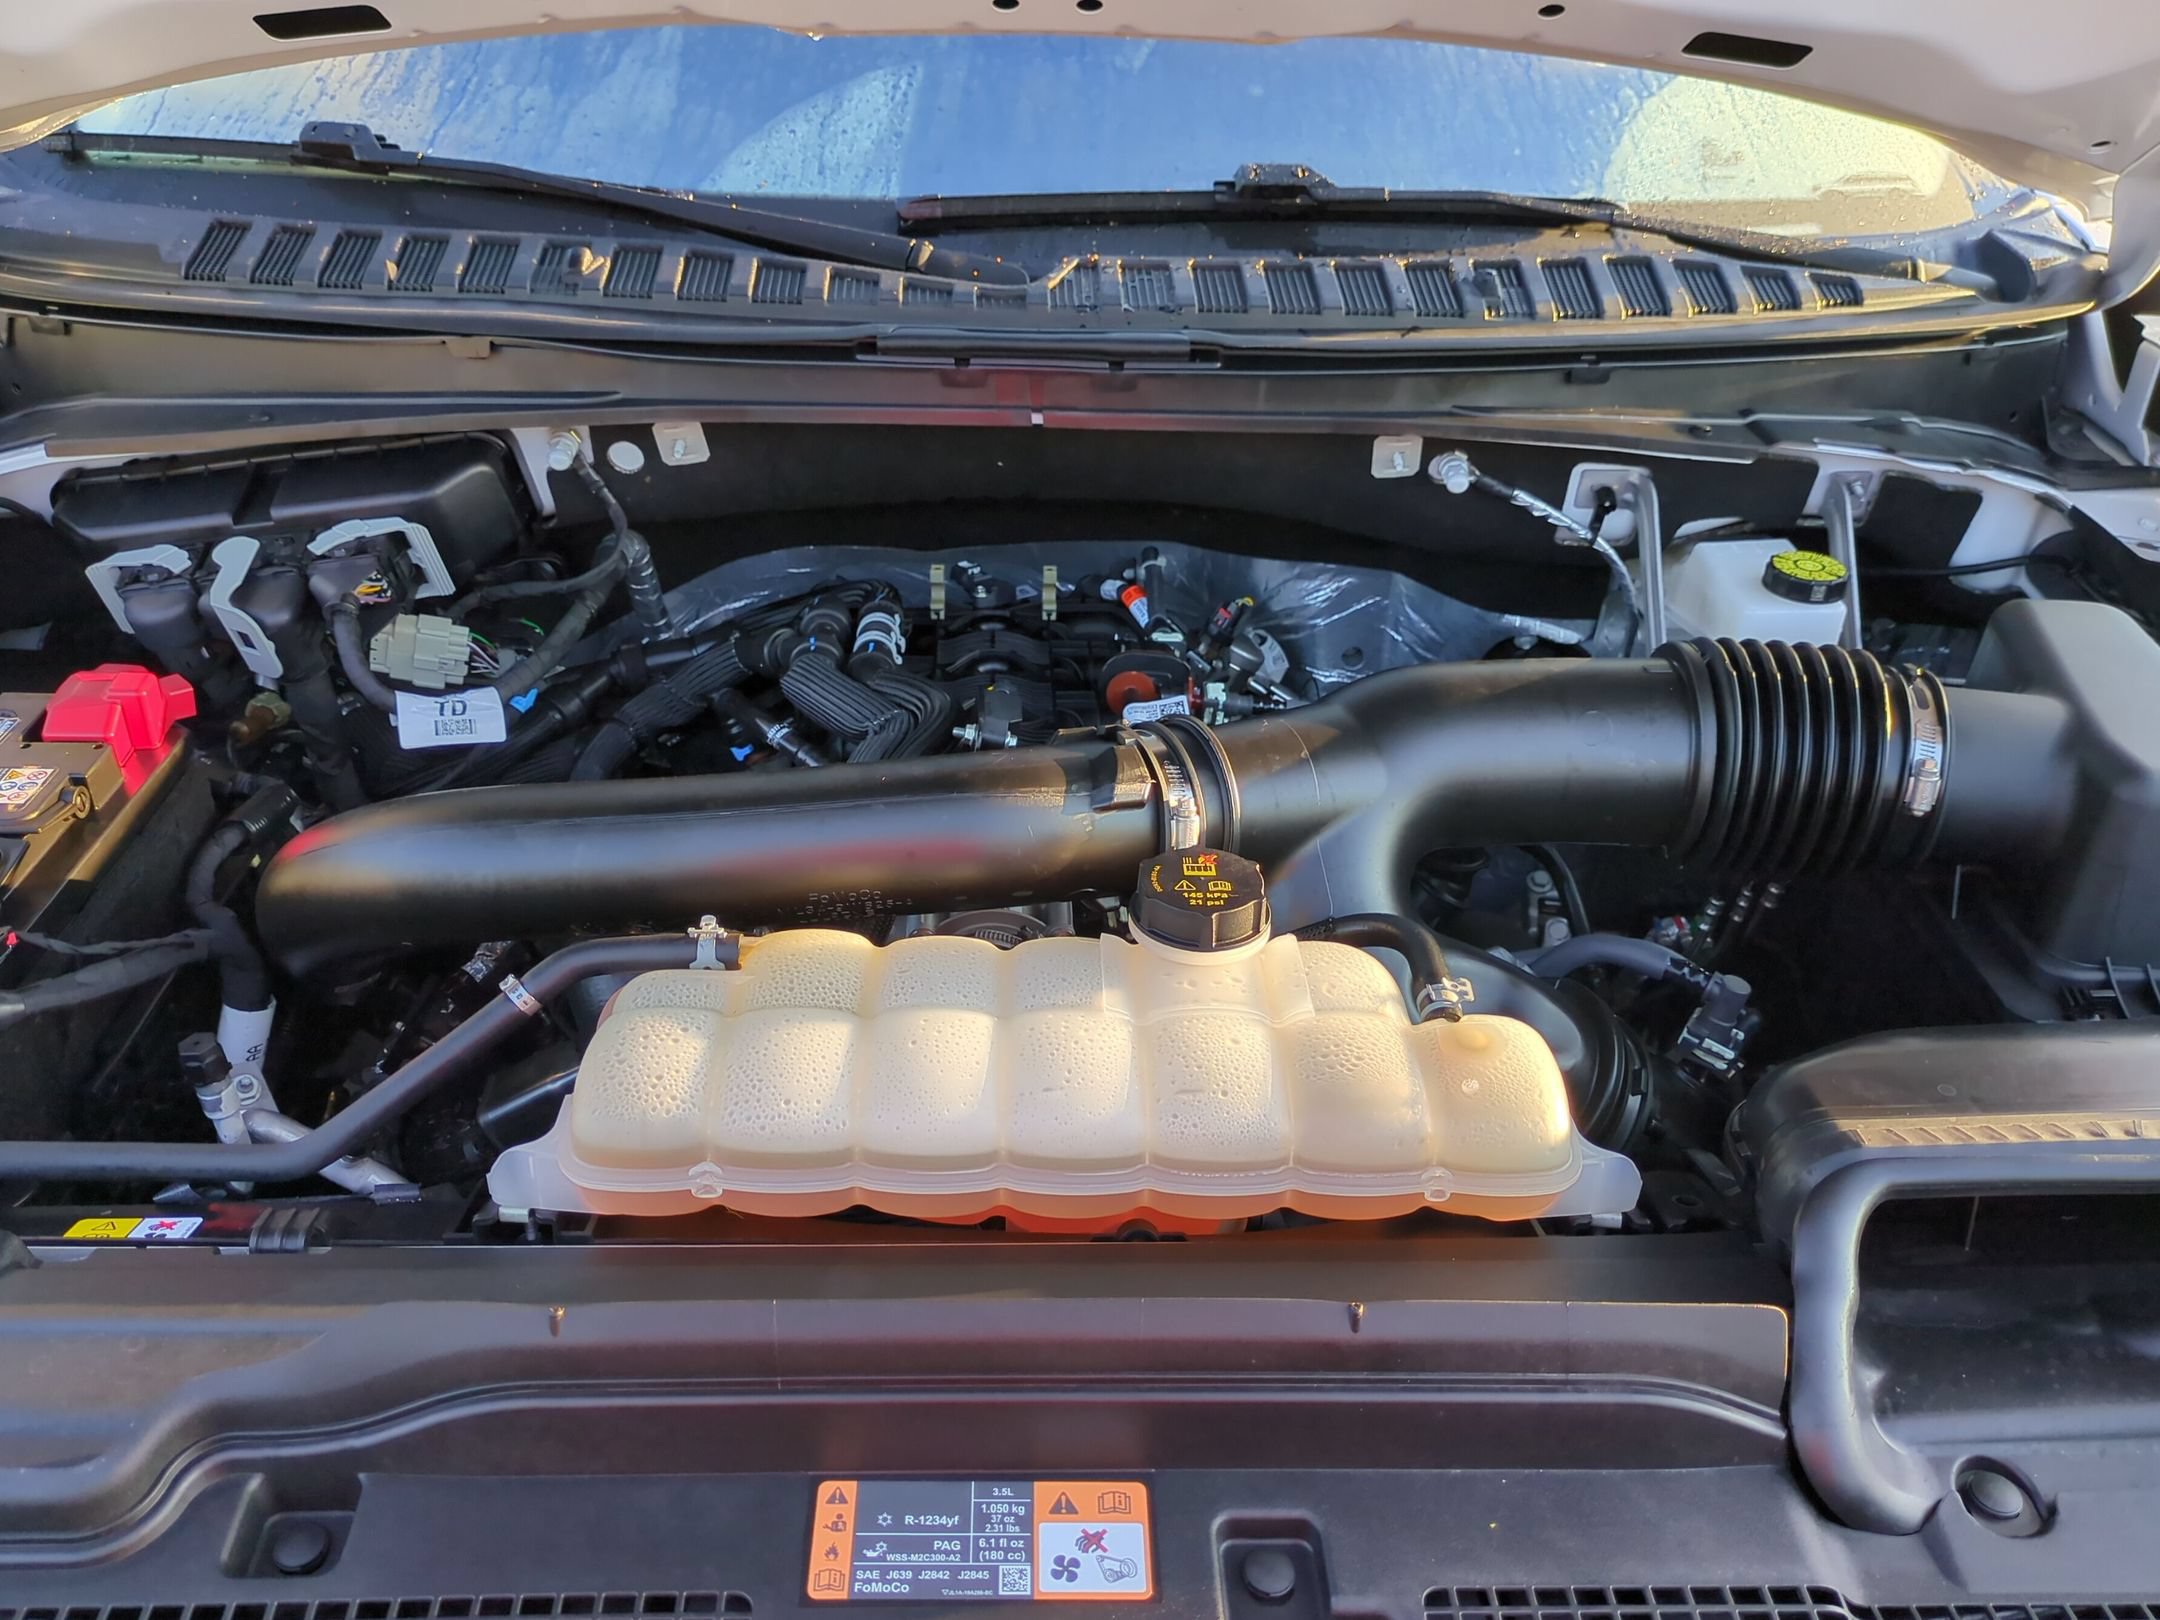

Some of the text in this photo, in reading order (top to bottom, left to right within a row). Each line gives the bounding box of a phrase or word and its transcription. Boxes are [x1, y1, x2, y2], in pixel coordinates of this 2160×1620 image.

[434, 699, 468, 717] TD
[992, 1487, 1014, 1496] 3.5L
[980, 1503, 1025, 1516] 1.050 kg
[904, 1515, 960, 1528] R-1234yf
[990, 1514, 1001, 1523] 37
[985, 1524, 1020, 1533] 2.31 lbs
[933, 1540, 961, 1551] PAG
[978, 1538, 1025, 1548] 6.1 fl oz
[886, 1553, 961, 1562] WSS-M2C300-A2
[979, 1551, 1026, 1562] (180 cc)
[856, 1570, 990, 1580] SAE J639 J2842 J2845
[854, 1582, 910, 1593] FoMoCo
